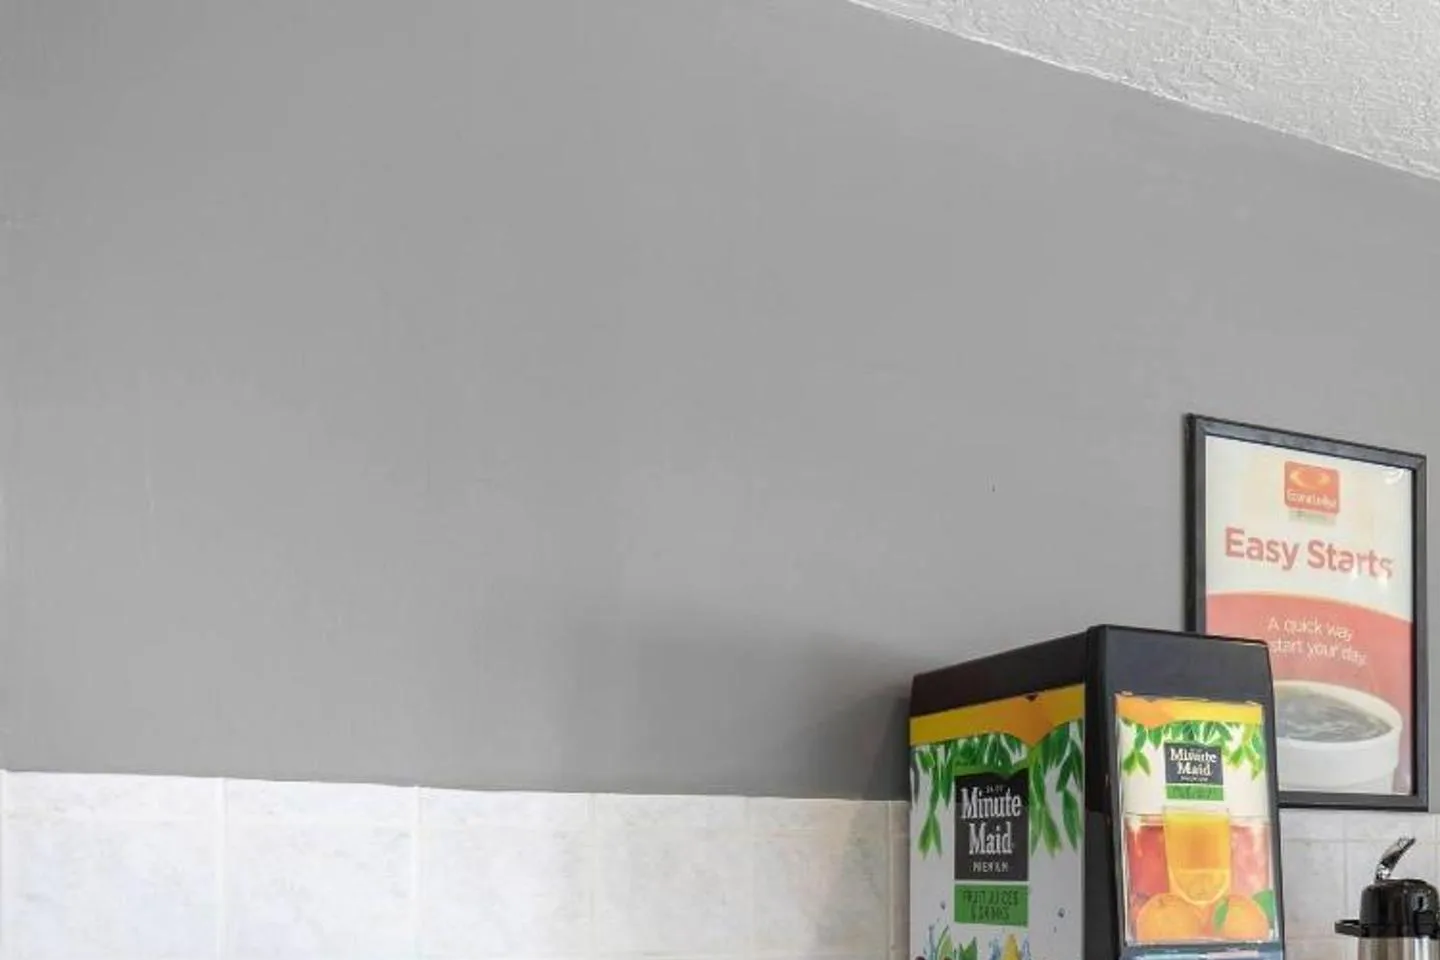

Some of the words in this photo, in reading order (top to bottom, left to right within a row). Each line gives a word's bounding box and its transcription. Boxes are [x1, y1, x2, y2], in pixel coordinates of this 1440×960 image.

[1225, 526, 1300, 571] Easy
[1307, 539, 1394, 579] Starts
[1267, 615, 1280, 632] A
[1283, 616, 1322, 637] quick
[1325, 622, 1353, 642] way
[1306, 641, 1339, 662] your
[1170, 747, 1217, 763] Minute
[1177, 761, 1212, 777] Maid
[960, 786, 1022, 819] Minute
[968, 821, 1013, 855] Maid
